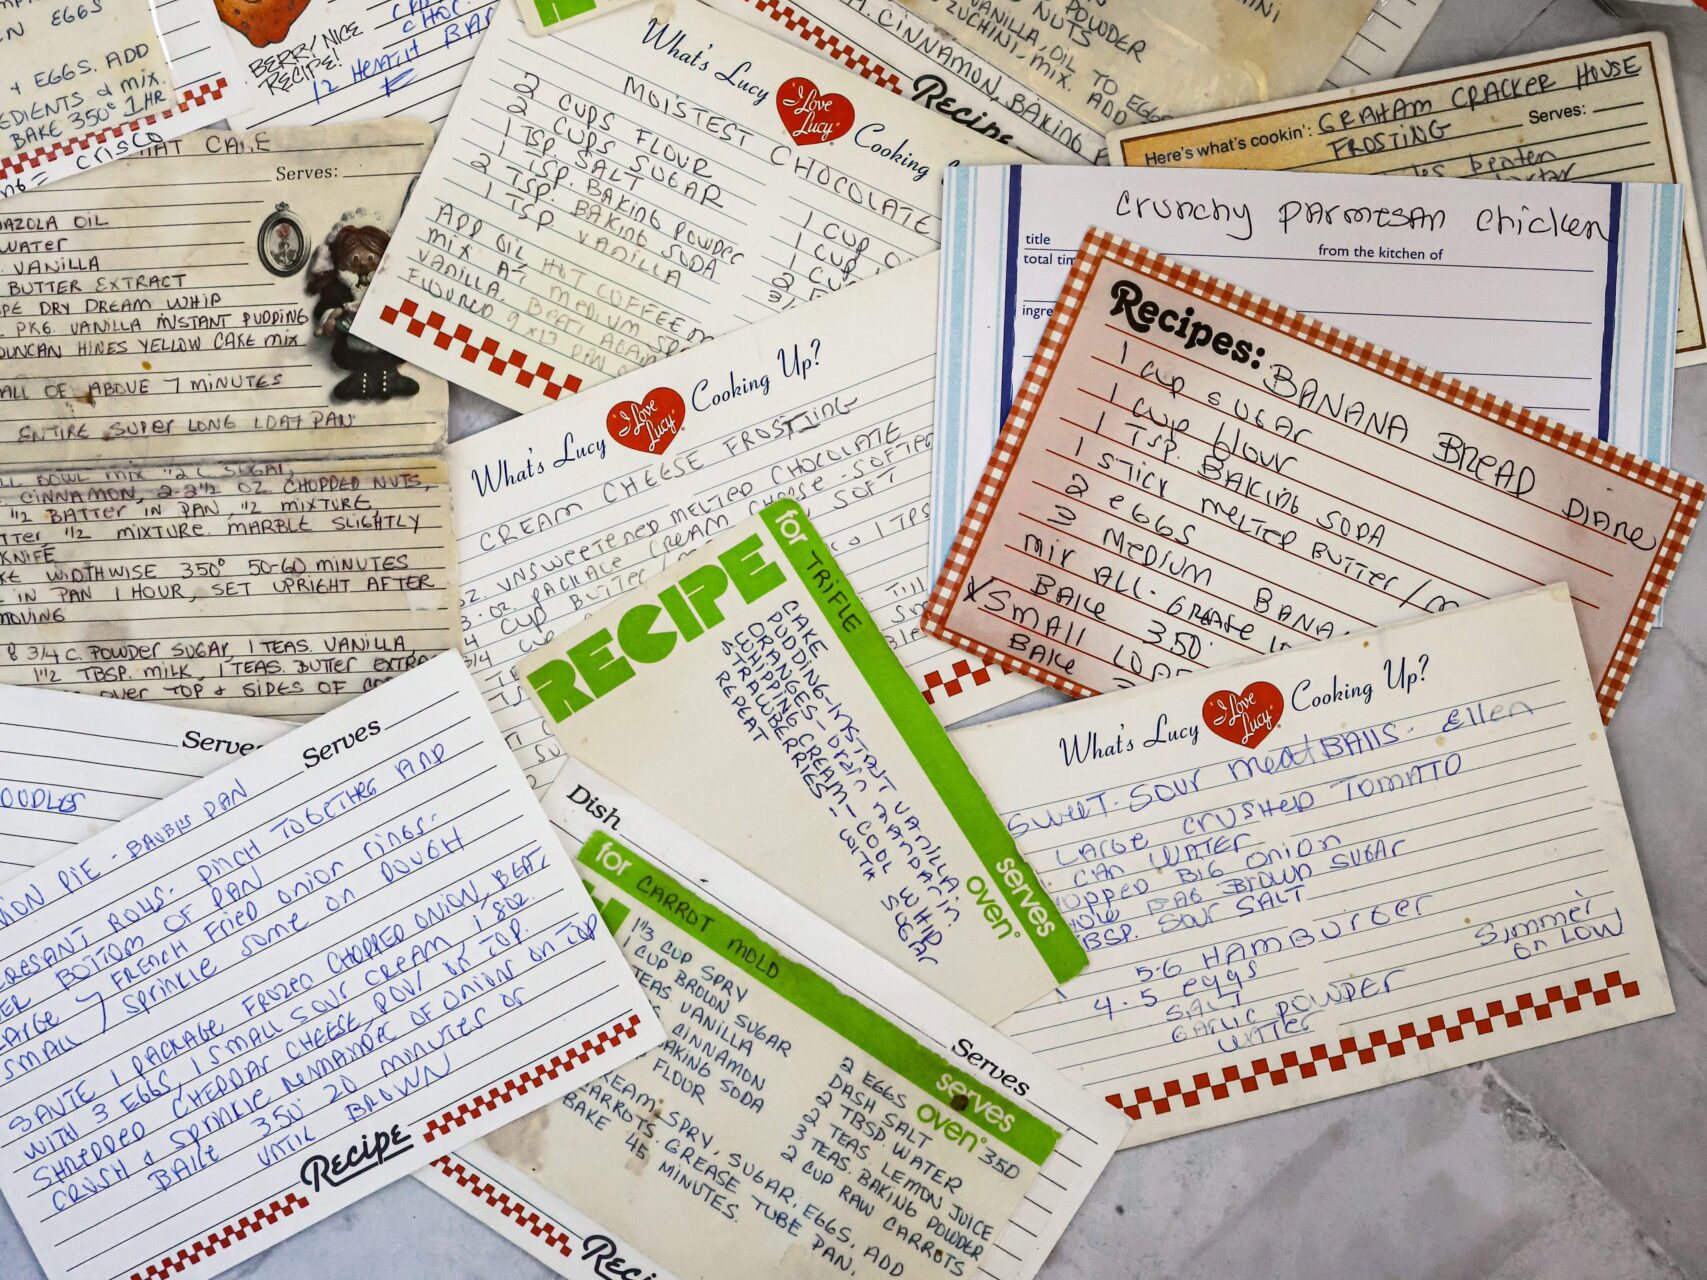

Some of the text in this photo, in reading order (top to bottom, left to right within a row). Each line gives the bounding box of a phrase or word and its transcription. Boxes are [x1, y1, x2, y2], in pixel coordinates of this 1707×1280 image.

[105, 42, 150, 69] ADD
[321, 20, 364, 50] NICE
[641, 17, 929, 182] What's Lucy Cooking
[1528, 102, 1587, 125] Serves:
[9, 123, 63, 151] BAKE
[1145, 144, 1194, 168] Here's
[1196, 134, 1248, 159] what's
[275, 165, 338, 182] Serves:
[1023, 253, 1076, 266] total tim
[1025, 233, 1051, 246] title
[1318, 243, 1444, 262] from the kitchen of
[8, 274, 188, 295] BUTTER EXTRACT
[40, 296, 154, 317] DRY DREAM
[141, 332, 256, 353] YELLOW CAKE
[1110, 279, 1266, 370] Recipes:
[471, 338, 822, 499] What's Lucy Cooking Up?
[1266, 361, 1410, 444] BANANA
[774, 508, 807, 546] for
[212, 580, 252, 598] SET
[367, 572, 435, 591] AFTER
[526, 532, 787, 723] RECIPE
[782, 600, 828, 659] CAKE
[715, 671, 770, 743] REPEAT
[1058, 652, 1430, 769] What's Lucy Cooking Up?
[301, 717, 383, 770] Serves
[565, 783, 623, 832] Dish
[593, 840, 632, 878] for
[995, 857, 1055, 938] serves
[635, 874, 781, 980] CARROT MOLD
[661, 940, 748, 1003] CUP SPRY
[634, 944, 792, 1057] CUP BROWN SUGAR
[652, 1058, 706, 1105] FLOUR
[951, 1038, 1030, 1097] Serves
[561, 1090, 612, 1134] BAKE
[828, 1073, 933, 1149] DASH SALT
[936, 1073, 1015, 1134] serves
[891, 1142, 963, 1195] WATER
